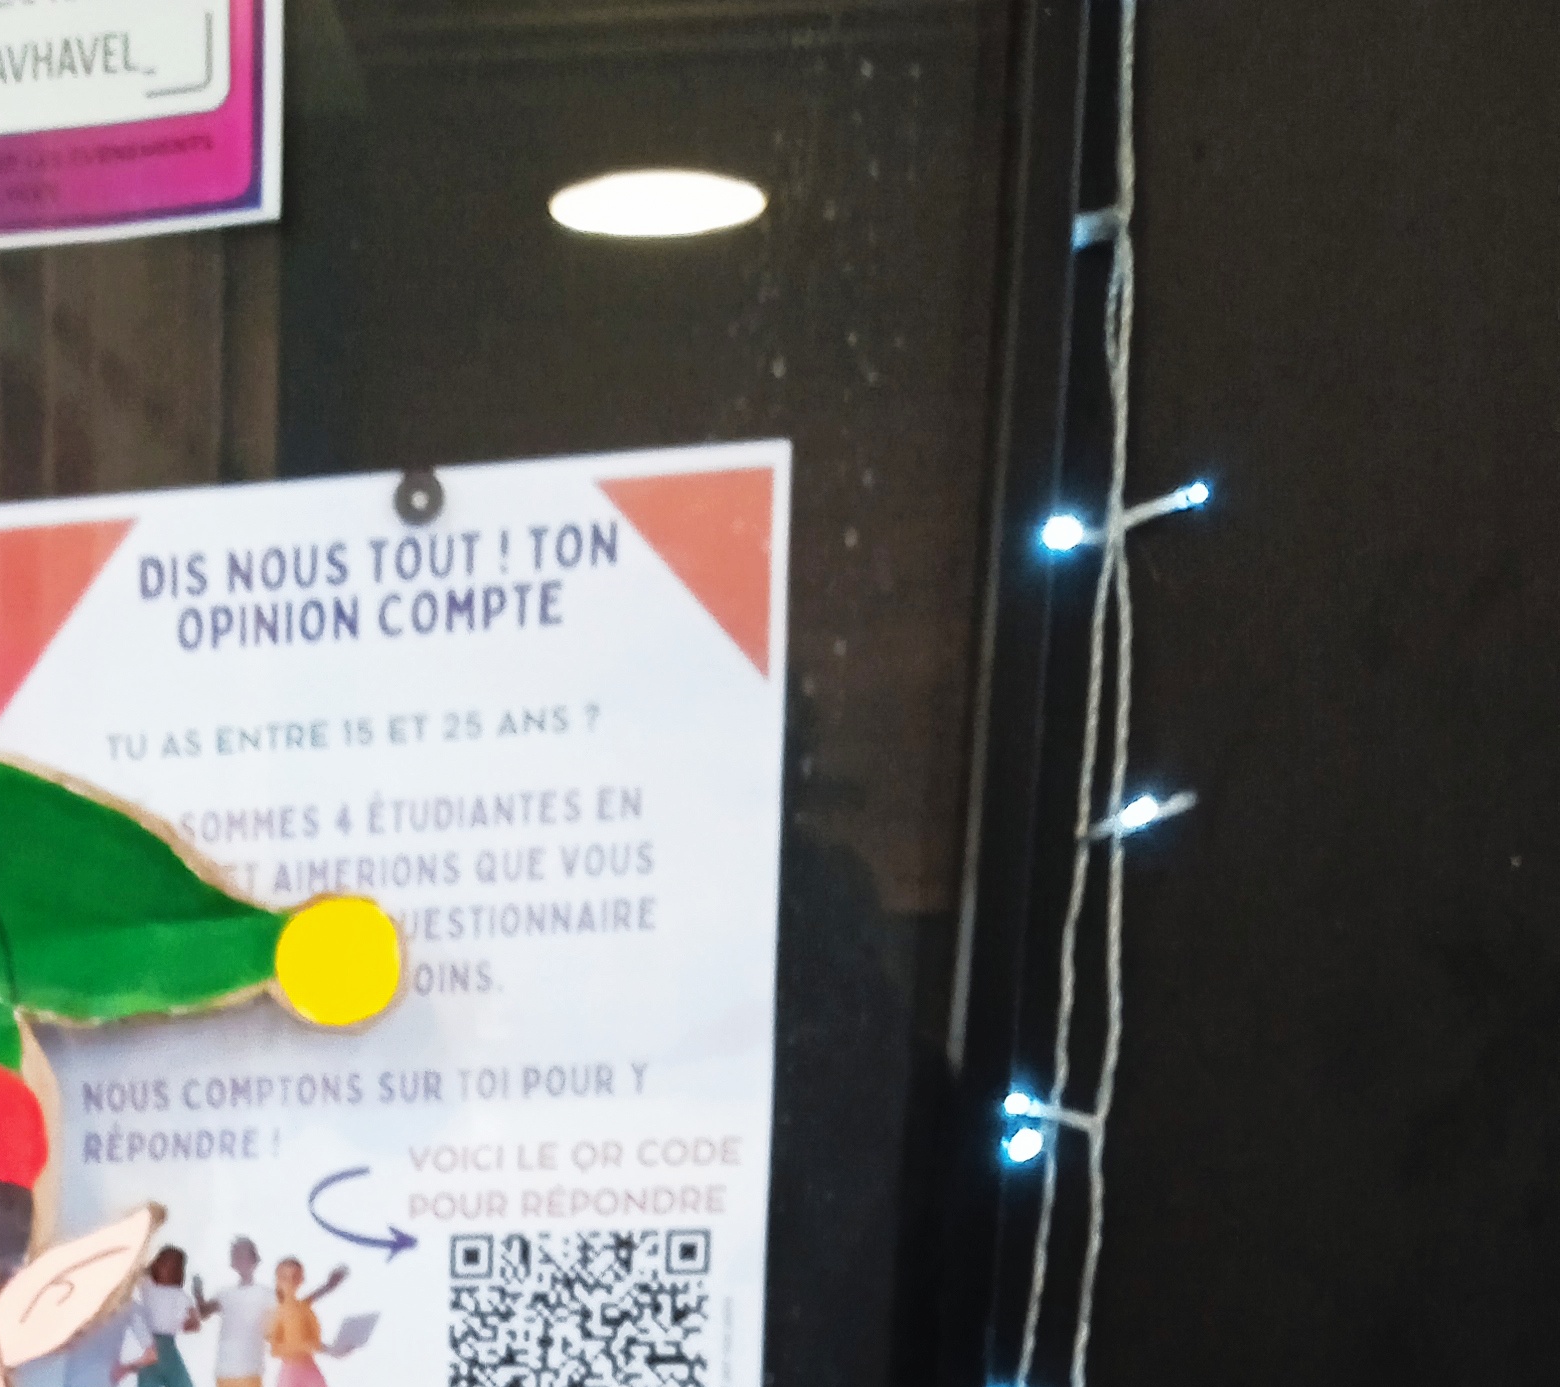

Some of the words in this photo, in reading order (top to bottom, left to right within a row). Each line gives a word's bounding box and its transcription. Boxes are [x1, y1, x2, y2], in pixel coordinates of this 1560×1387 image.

[140, 552, 208, 600] DIS
[227, 541, 349, 595] NOUS
[368, 530, 481, 584] TOUT
[529, 521, 618, 573] TON
[177, 596, 360, 652] OPINION
[378, 579, 563, 638] COMPTE
[106, 732, 147, 761] TU
[160, 730, 202, 758] AS
[215, 719, 329, 756] ENTRE
[342, 717, 374, 747] 15
[388, 713, 429, 745] ET
[443, 711, 484, 742] 25
[496, 704, 570, 738] ANS
[180, 803, 321, 844] SOMMES
[334, 802, 354, 836] 4
[367, 788, 581, 836] ÉTUDIANTES
[597, 785, 644, 822] EN
[273, 851, 462, 895] AIMERIONS
[474, 847, 545, 885] QUE
[560, 840, 655, 879] VOUS
[402, 896, 660, 942] UESTIONNAIRE
[81, 1077, 171, 1115] NOUS
[181, 1071, 364, 1111] COMPTONS
[378, 1068, 444, 1105] SUR
[457, 1065, 510, 1101] TOI
[520, 1062, 615, 1099] POUR
[630, 1060, 649, 1096] Y
[82, 1120, 260, 1165] RÉPONDRE
[408, 1144, 505, 1174] VOICI
[516, 1140, 560, 1172] LE
[570, 1139, 624, 1174] QR
[636, 1134, 743, 1169] CODE
[408, 1187, 509, 1221] POUR
[520, 1183, 728, 1219] RÉPONDRE
